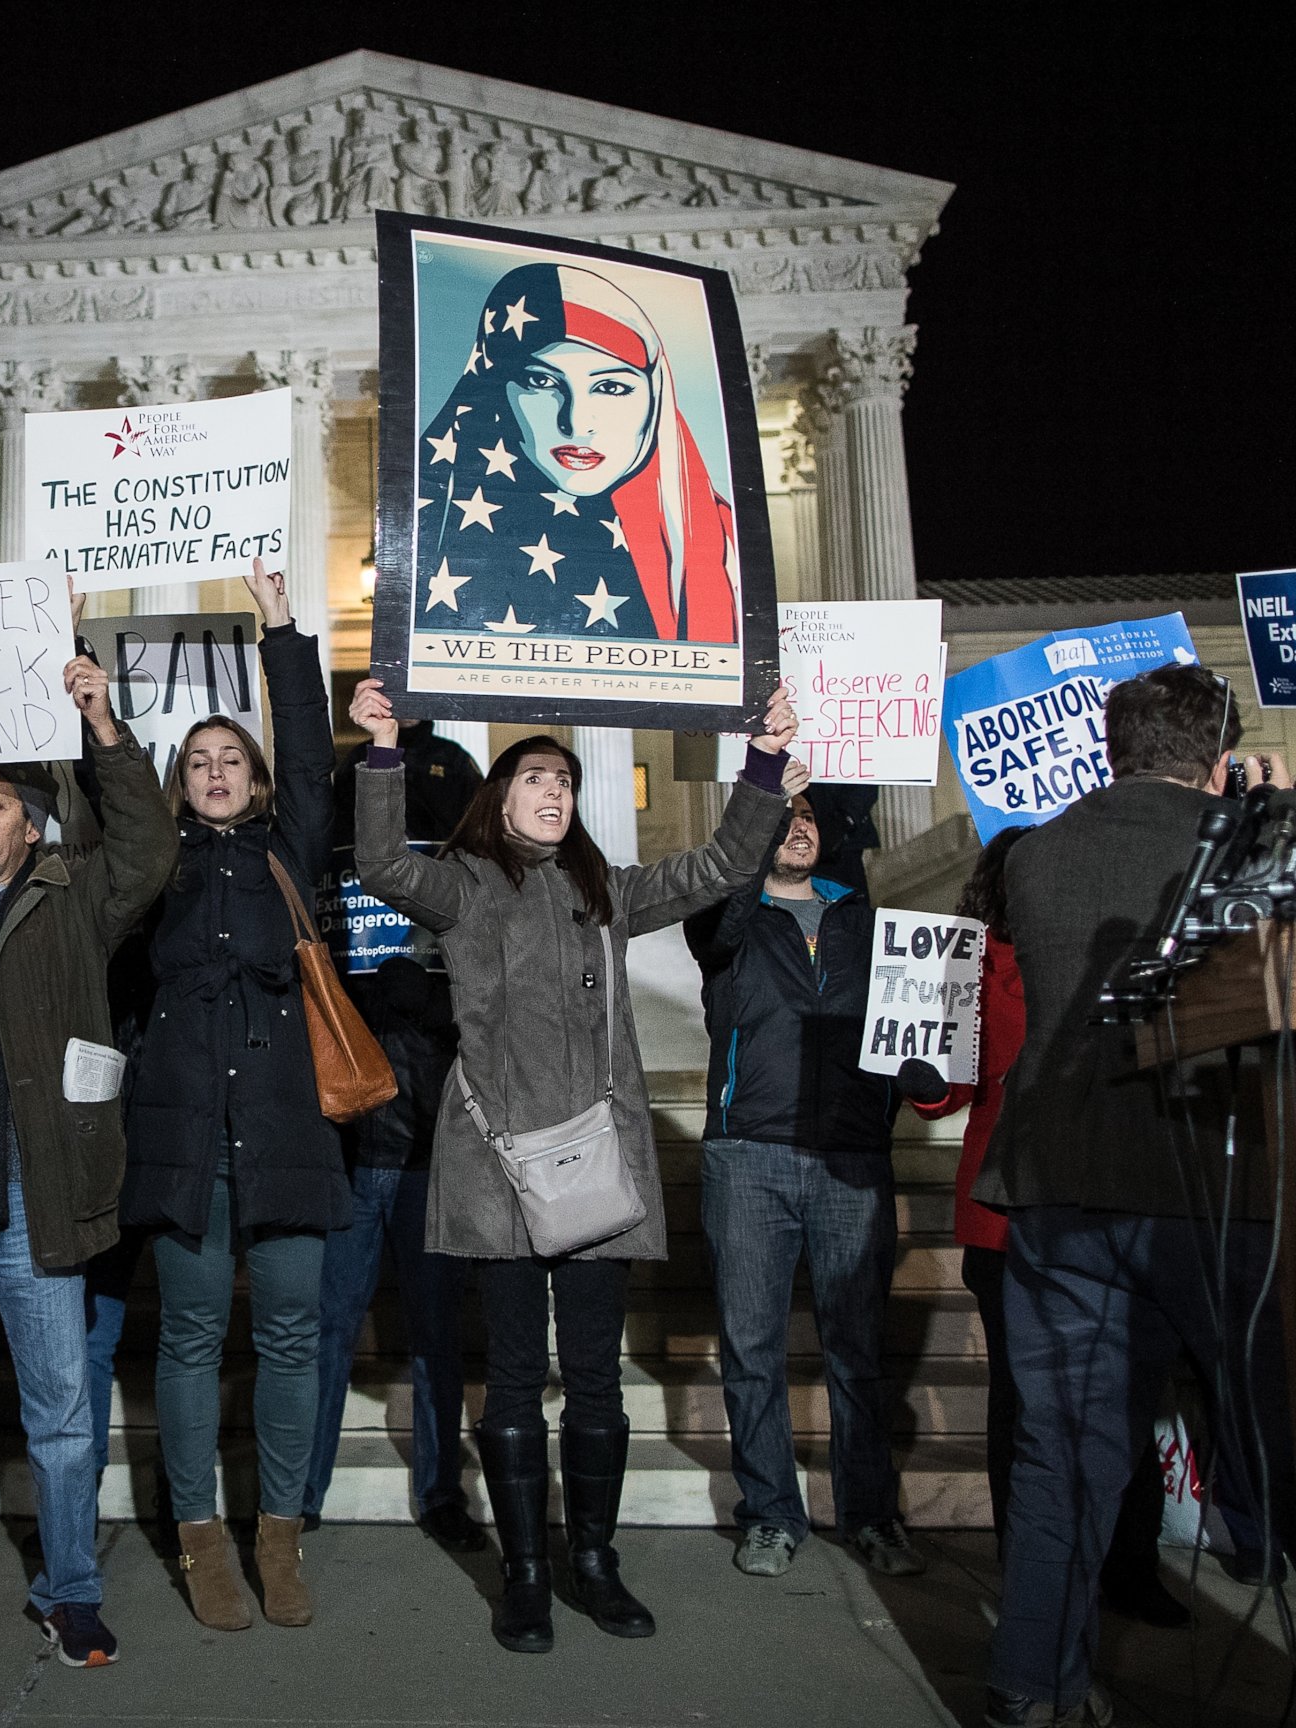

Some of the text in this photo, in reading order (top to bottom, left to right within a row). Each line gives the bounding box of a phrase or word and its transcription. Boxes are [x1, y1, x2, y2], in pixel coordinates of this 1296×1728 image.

[139, 412, 182, 424] PEOPLE
[143, 431, 208, 446] AMERICAN
[154, 423, 196, 435] FOR THE
[150, 446, 177, 457] WAY
[41, 458, 290, 509] THE CONSTITUTION
[106, 504, 211, 538] HAS NO
[210, 528, 282, 562] FACTS
[785, 609, 829, 621] PEOPLE
[1246, 596, 1294, 618] NEIL
[801, 621, 843, 632] FOR THE
[790, 631, 856, 643] AMERICAN
[1092, 629, 1157, 645] NATIONAL
[1097, 639, 1161, 655] ABORTION
[442, 639, 711, 669] WE THE PEOPLE
[797, 644, 825, 654] WAY
[1053, 641, 1087, 665] naf
[1101, 649, 1165, 665] FEDERATION
[115, 624, 251, 720] BAN
[812, 659, 903, 696] deserve
[915, 673, 929, 692] a
[456, 674, 694, 692] ARE GREATER THAN FEAR
[970, 727, 1083, 788] SAFE,
[1004, 782, 1029, 809] &
[884, 921, 978, 960] LOVE
[870, 1016, 959, 1057] HATE
